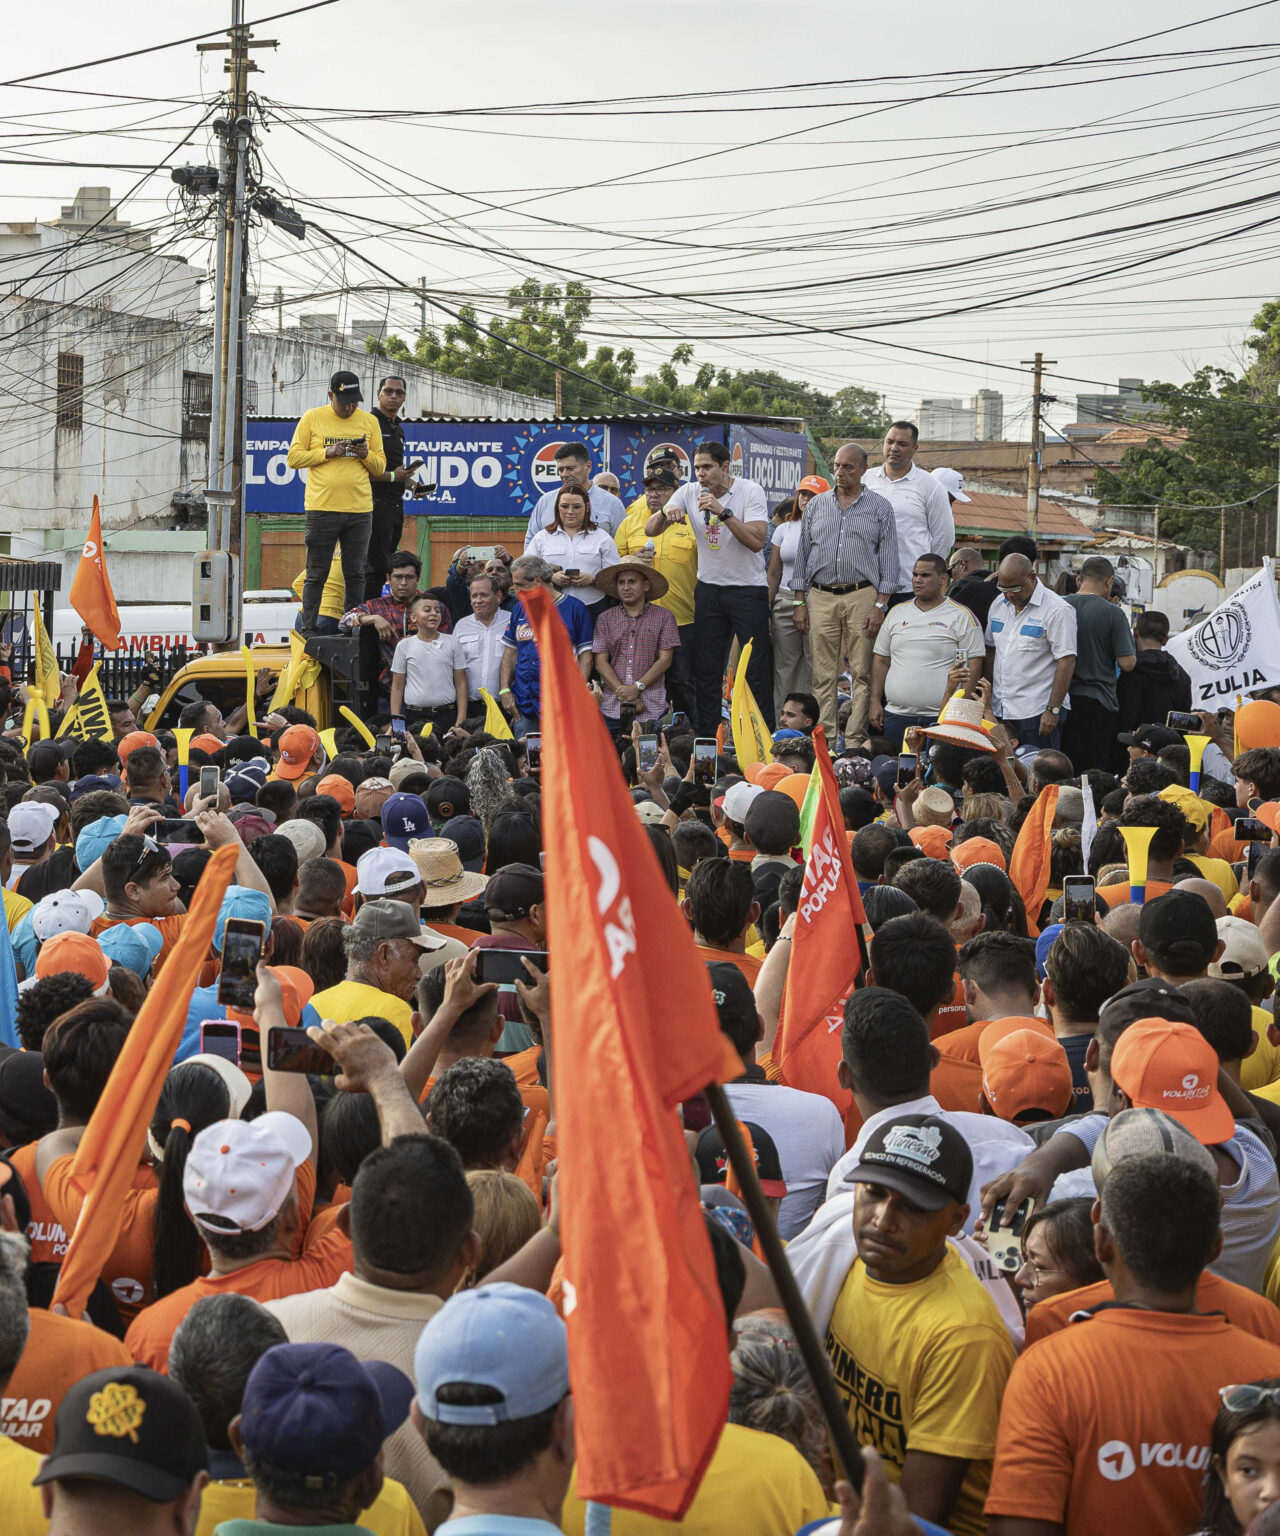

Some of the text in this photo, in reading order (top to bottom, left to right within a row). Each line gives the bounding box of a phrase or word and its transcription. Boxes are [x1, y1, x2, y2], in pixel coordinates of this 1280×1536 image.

[1198, 668, 1268, 701] ZULIA
[402, 817, 417, 832] LA
[884, 1130, 940, 1160] Vanessa
